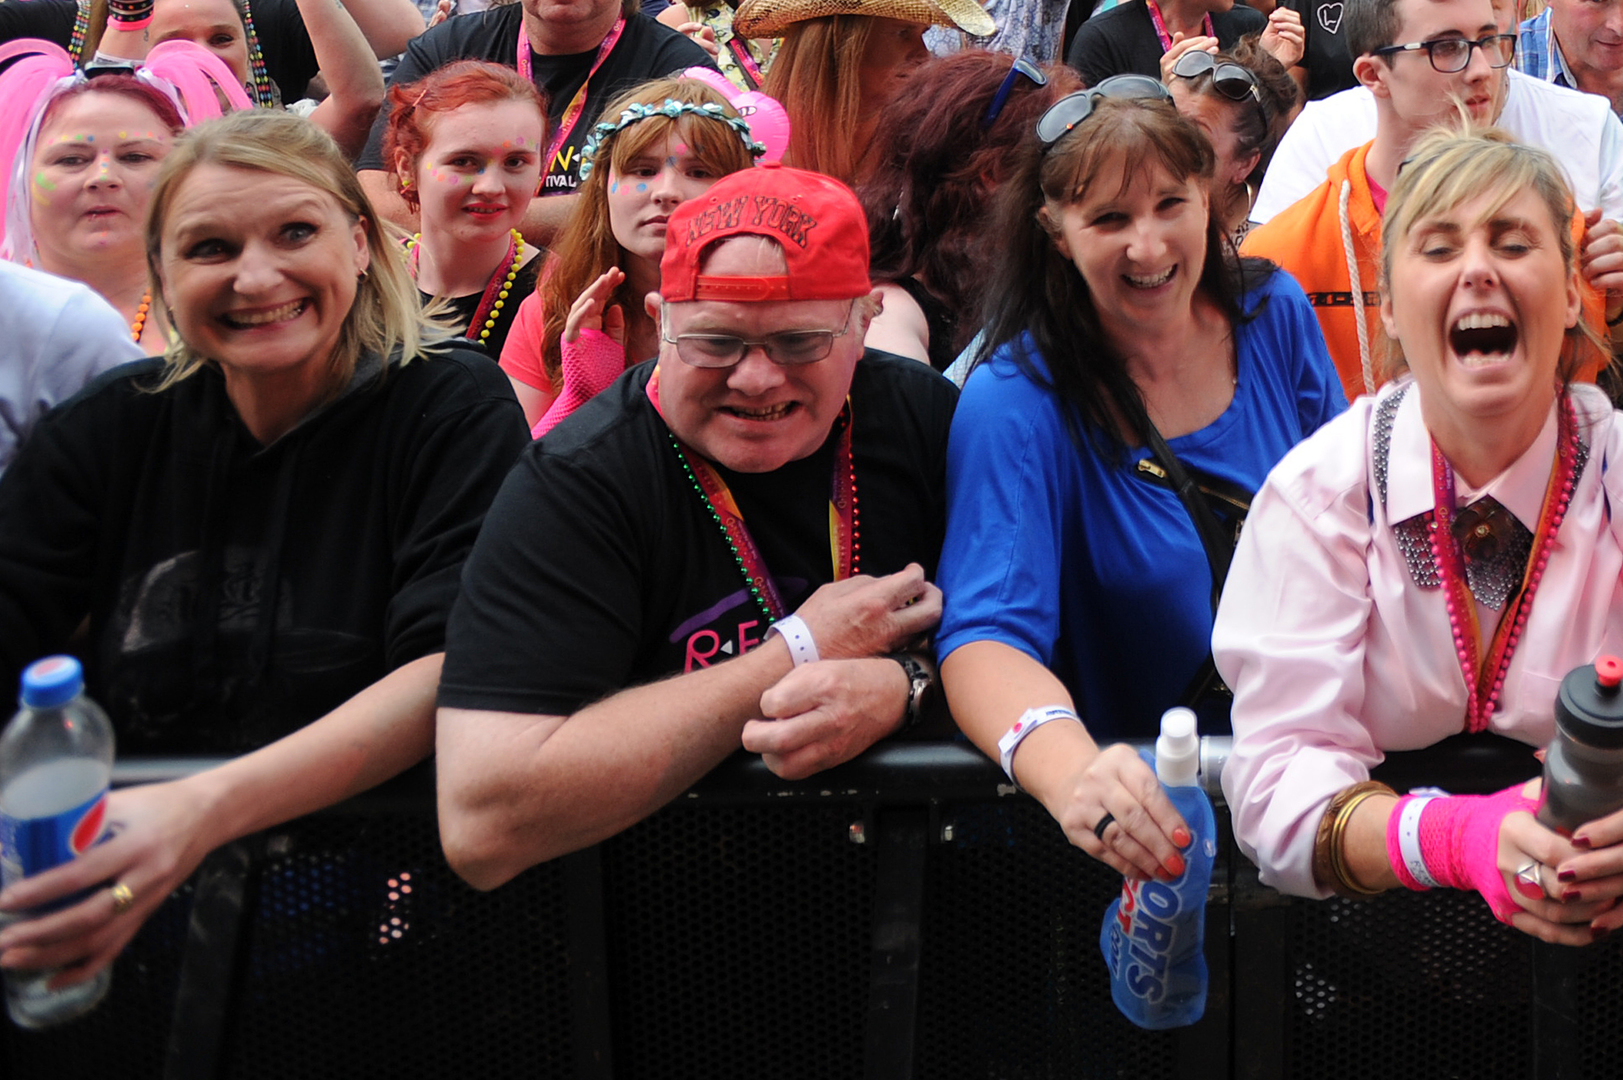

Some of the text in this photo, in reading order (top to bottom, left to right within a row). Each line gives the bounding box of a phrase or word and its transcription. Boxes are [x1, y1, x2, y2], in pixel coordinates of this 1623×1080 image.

[546, 174, 577, 187] TIVAL
[686, 195, 817, 249] NEW YORK
[1126, 830, 1198, 1005] ORTS
